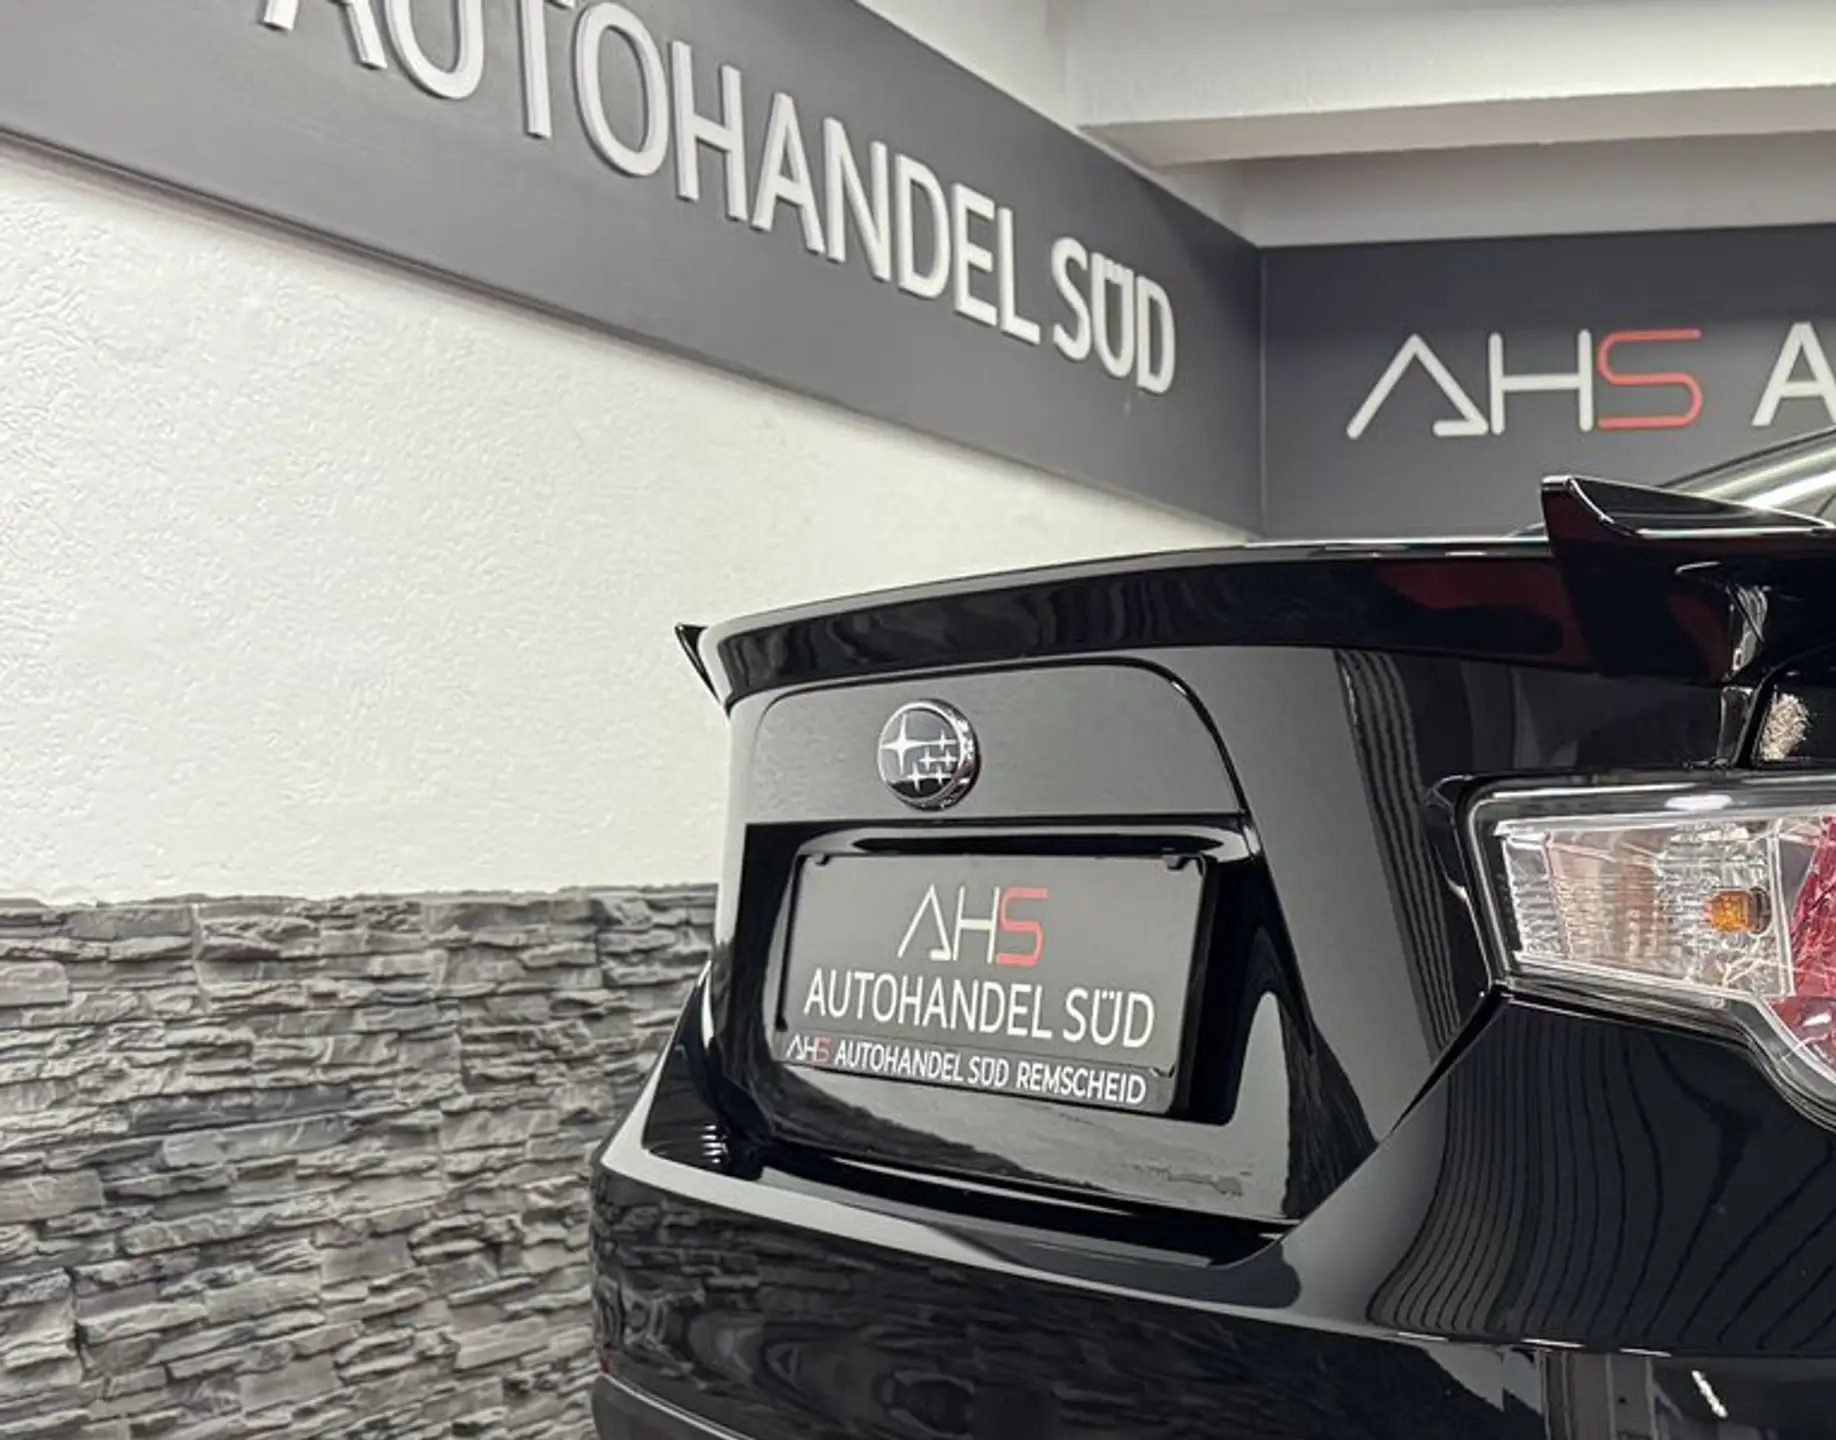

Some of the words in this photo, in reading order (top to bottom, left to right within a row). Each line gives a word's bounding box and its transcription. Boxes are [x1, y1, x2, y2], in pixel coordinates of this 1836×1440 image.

[1051, 237, 1176, 396] SÜD
[1346, 328, 1702, 439] AHS
[897, 884, 1049, 966] AHS
[803, 967, 1053, 1039] AUTOHANDEL
[1062, 987, 1156, 1049] SÜD
[785, 1033, 831, 1062] AHS
[834, 1038, 964, 1082] AUTOHANDEL
[1015, 1060, 1147, 1105] REMSCHEID
